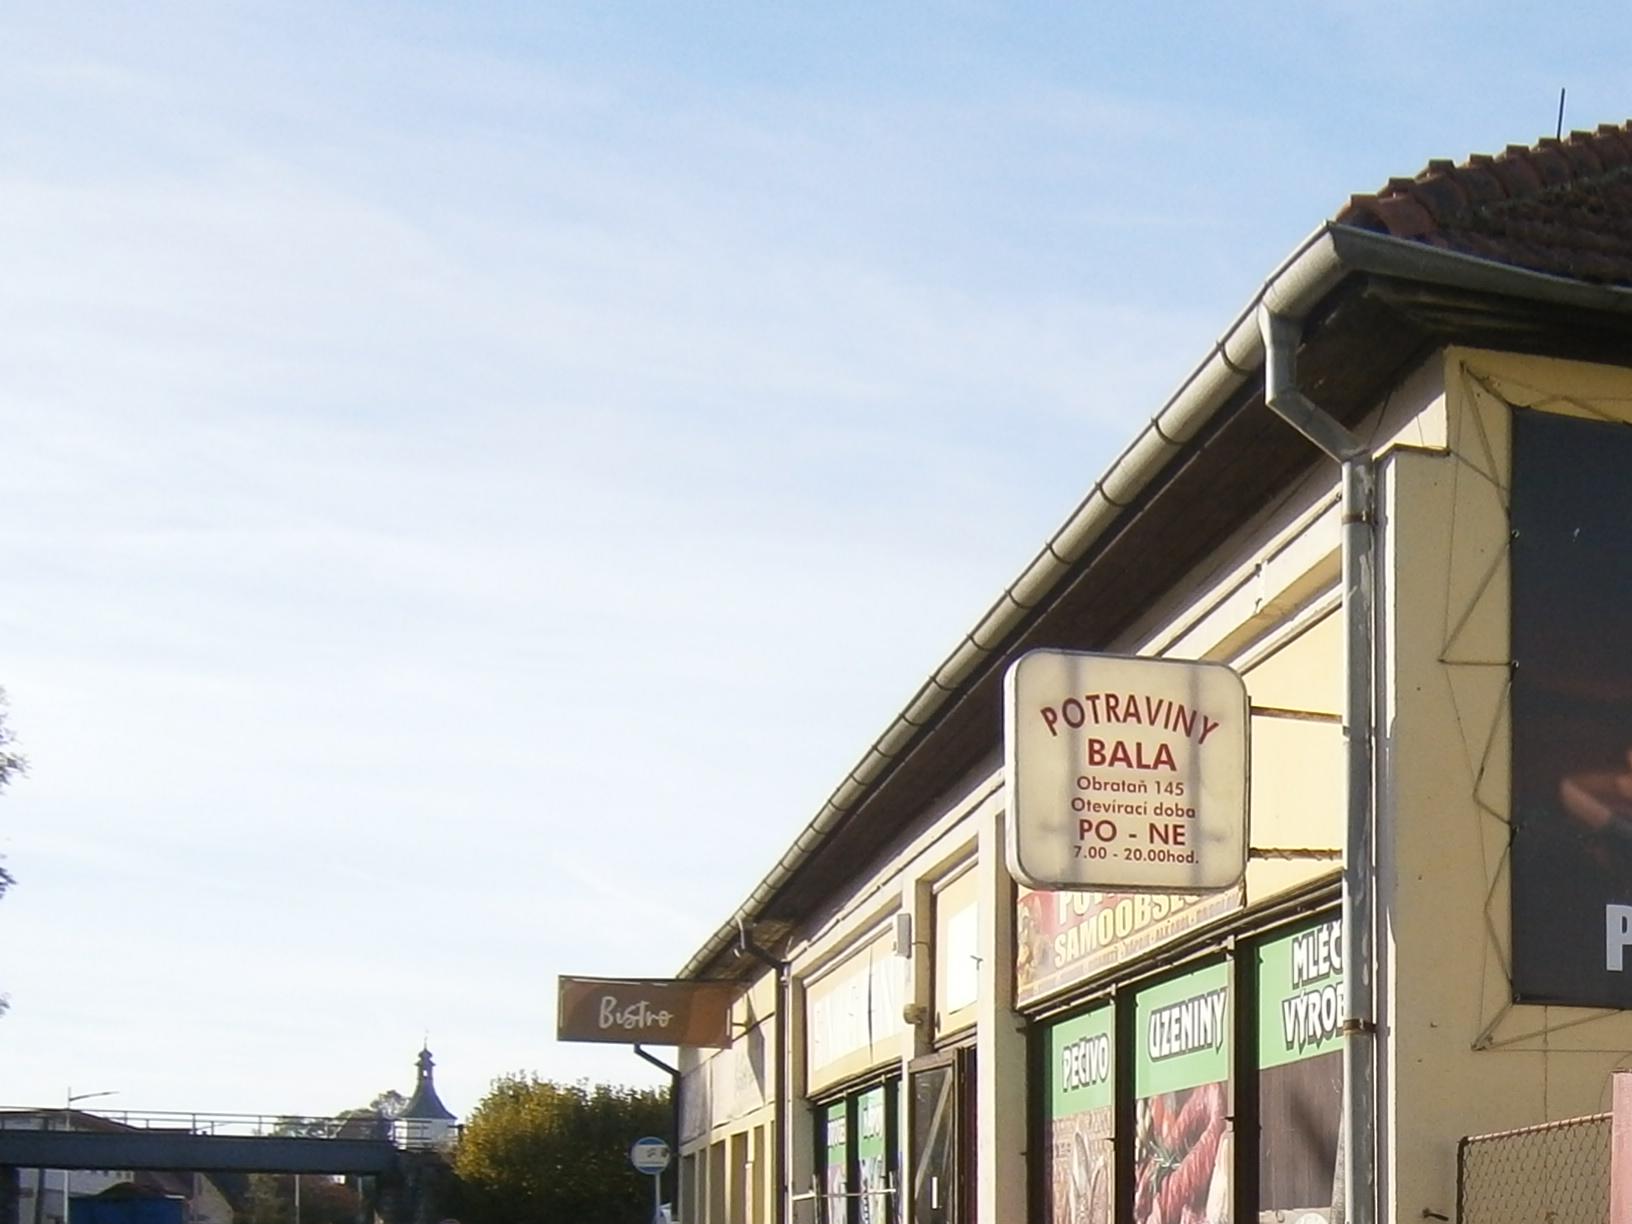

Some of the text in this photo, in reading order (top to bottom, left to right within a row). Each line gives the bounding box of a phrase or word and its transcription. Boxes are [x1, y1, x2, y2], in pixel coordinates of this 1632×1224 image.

[1040, 693, 1219, 744] POTRAVINY
[1087, 738, 1177, 771] BALA
[1076, 776, 1184, 796] Obrataň 145
[1153, 801, 1196, 818] doba
[1078, 819, 1117, 842] PO
[1148, 823, 1186, 845] NE
[1073, 845, 1107, 859] 7.00
[1124, 848, 1199, 864] 20.00hod.
[1293, 920, 1343, 987] MLÉČ
[599, 996, 675, 1029] Bistro
[1149, 989, 1227, 1061] UZENINY
